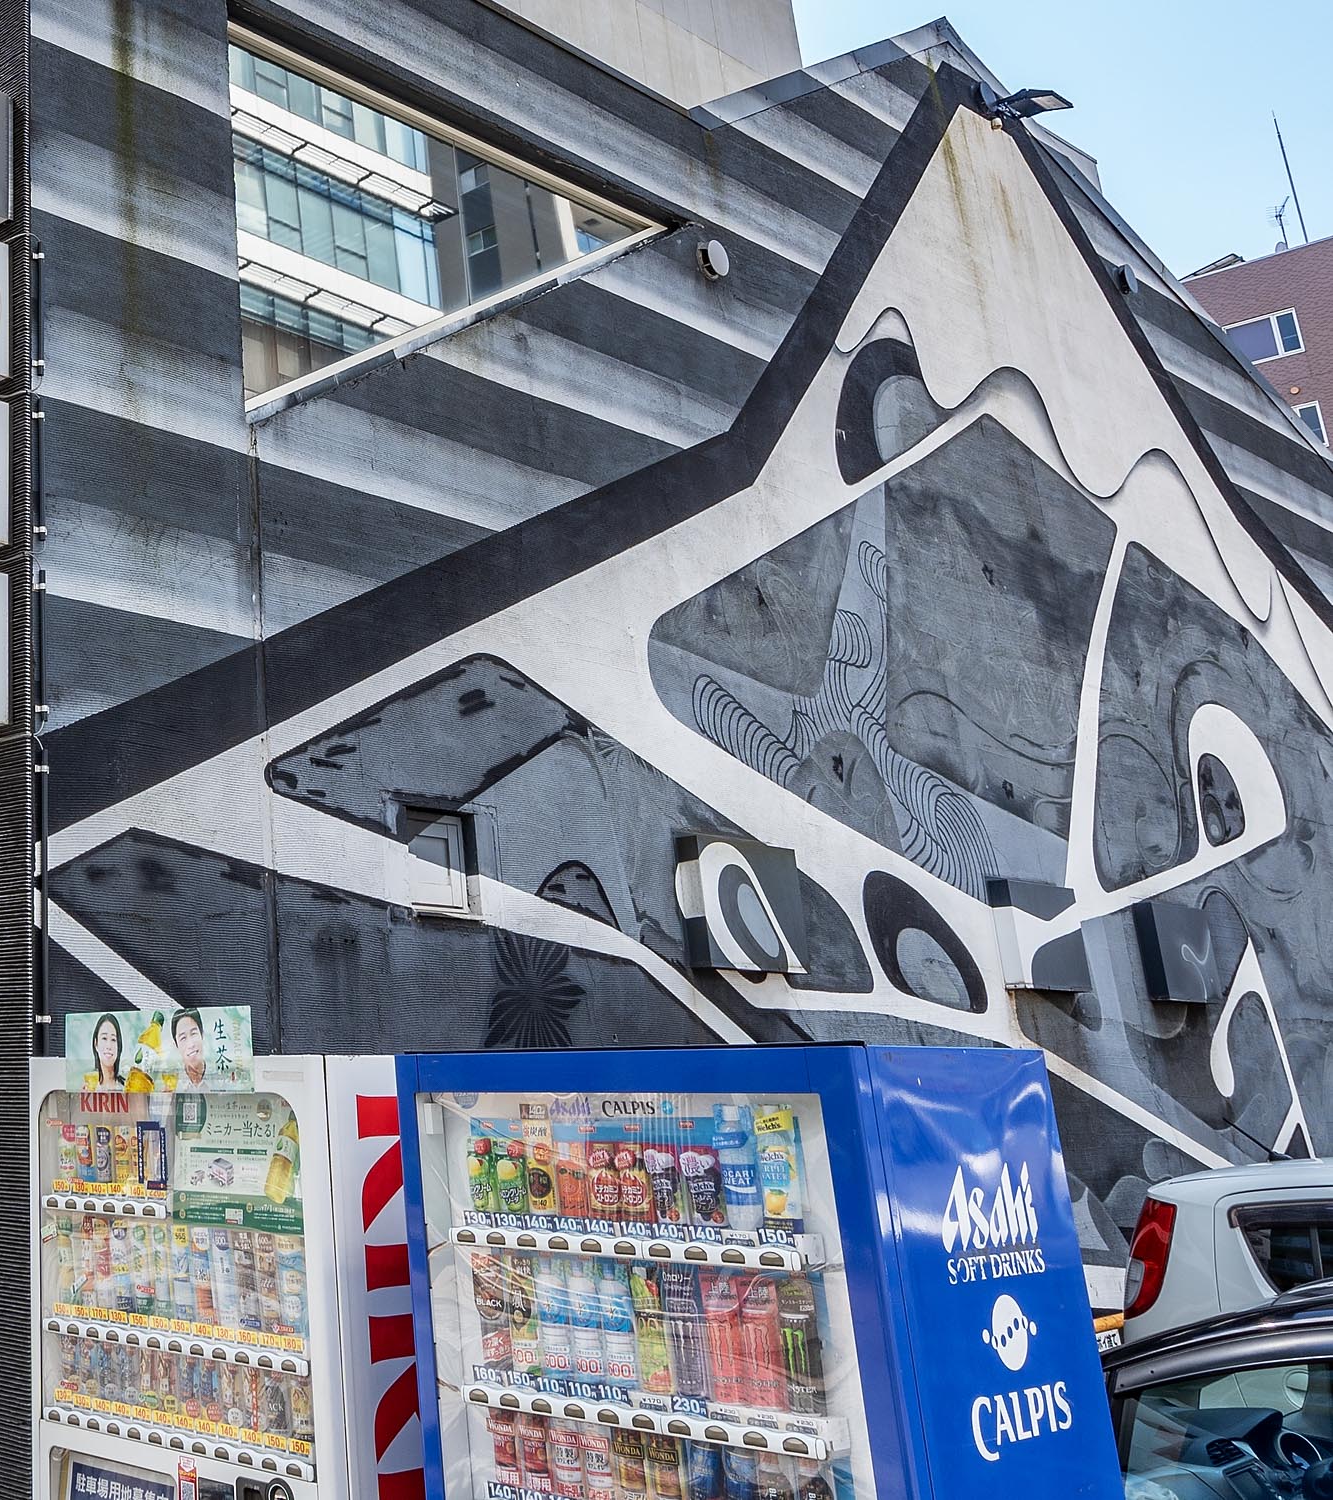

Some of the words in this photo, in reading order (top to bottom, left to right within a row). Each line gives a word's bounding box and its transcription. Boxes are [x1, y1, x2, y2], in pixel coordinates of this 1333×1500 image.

[213, 1018, 233, 1071] 生茶
[80, 1092, 129, 1113] KIRIN
[602, 1100, 655, 1117] CALPIS
[942, 1161, 1038, 1254] Asahi
[947, 1254, 988, 1286] SOFT
[991, 1248, 1046, 1280] DRINKS
[476, 1297, 503, 1309] BLACK
[971, 1380, 1073, 1462] CALPIS
[550, 1431, 577, 1444] WONDA
[580, 1436, 606, 1449] WONDA
[614, 1441, 641, 1455] WONDA
[648, 1447, 675, 1462] WONDA
